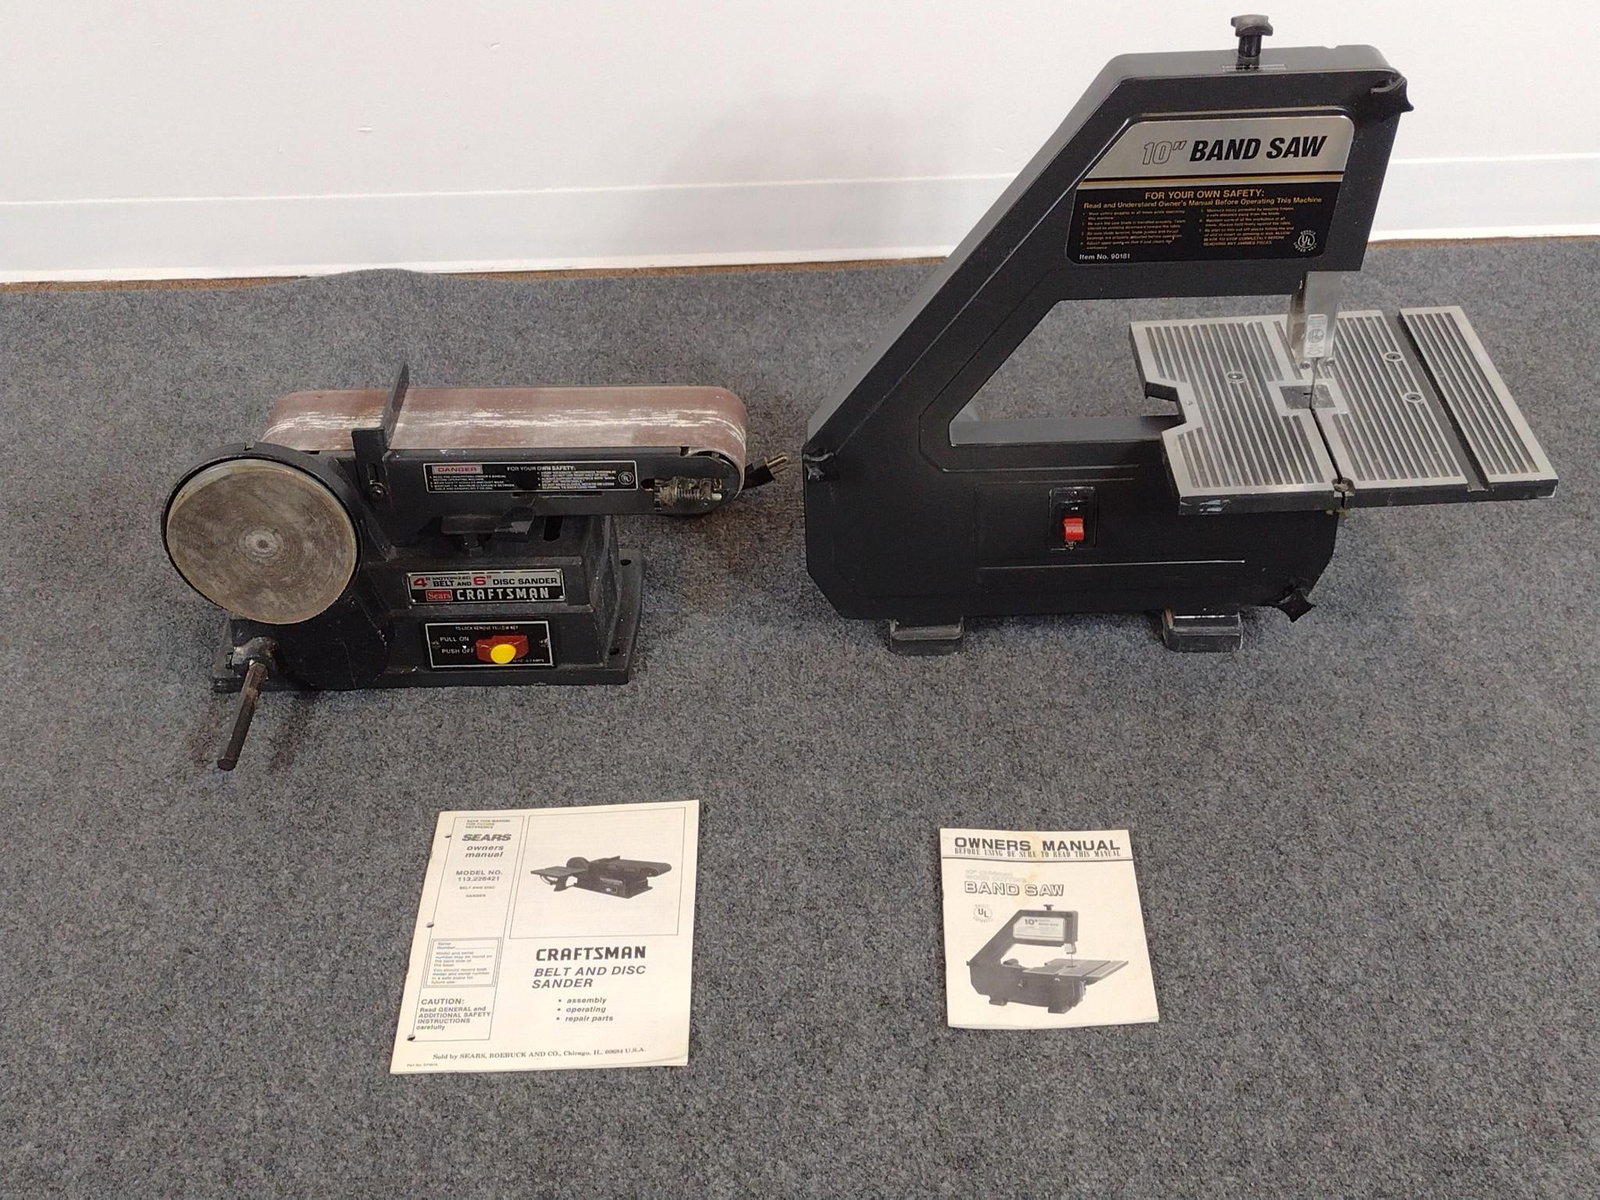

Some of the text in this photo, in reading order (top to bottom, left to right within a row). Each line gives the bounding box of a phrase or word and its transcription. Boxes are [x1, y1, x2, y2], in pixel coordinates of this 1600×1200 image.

[1142, 136, 1328, 165] 10" BAND SAW
[1145, 189, 1264, 200] FOR YOUR OWN SAFETY:
[413, 577, 431, 587] 4"
[473, 575, 492, 585] 6"
[493, 578, 515, 586] DISC
[518, 577, 558, 585] SANDER
[428, 587, 549, 600] Sears CRAFTSMAN
[462, 833, 512, 841] SEARS
[954, 837, 1120, 851] OWNERS MANUAL
[964, 880, 1064, 897] BAND SAW
[978, 908, 989, 918] UL
[536, 946, 646, 961] CRAFTSMAN
[534, 965, 646, 977] BELT AND DISC
[532, 978, 593, 989] SANDER
